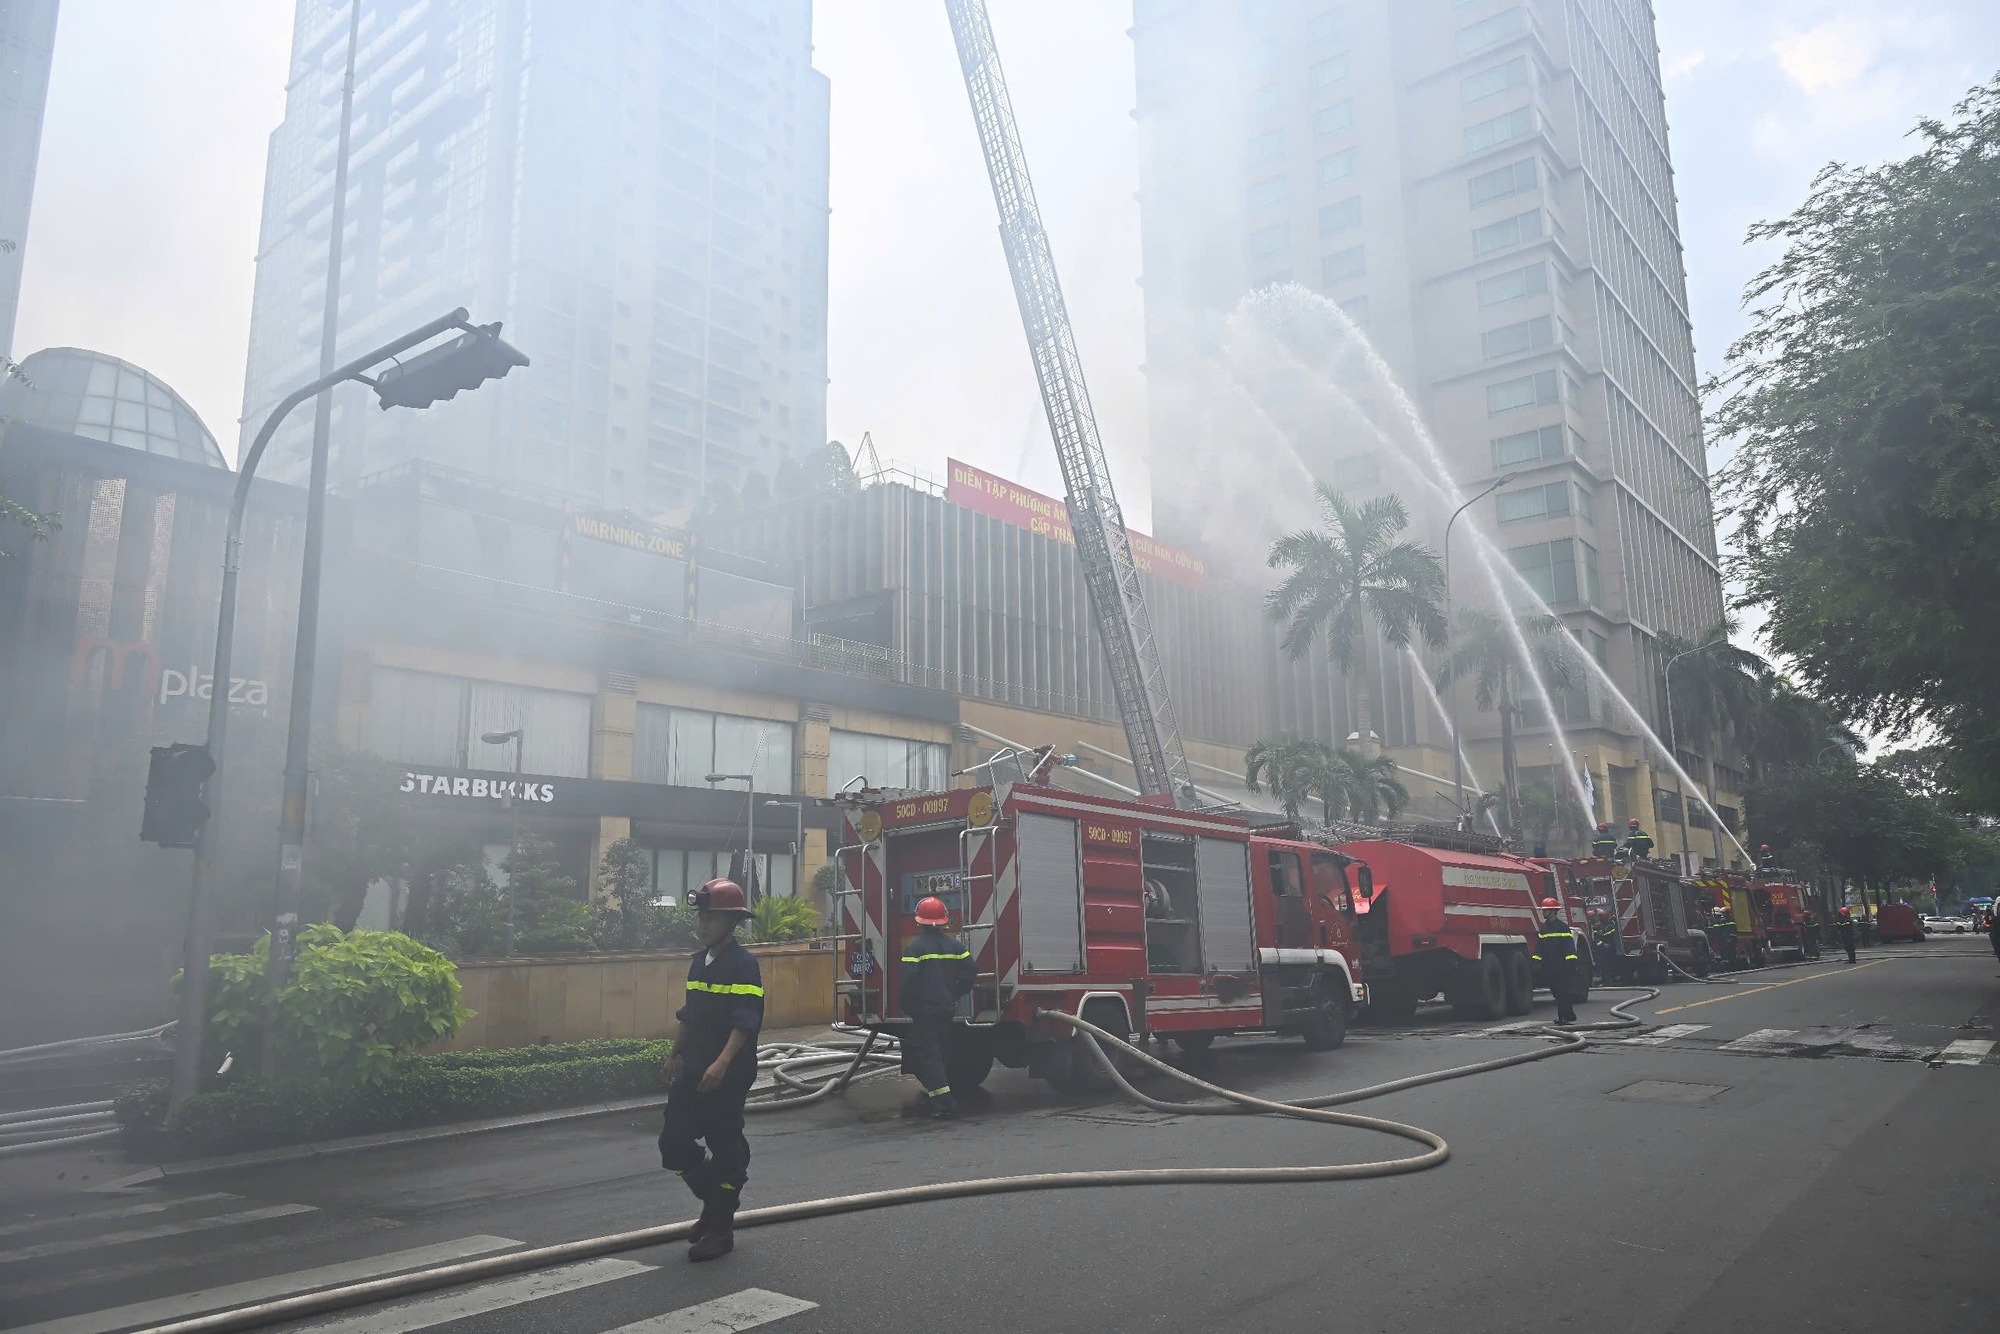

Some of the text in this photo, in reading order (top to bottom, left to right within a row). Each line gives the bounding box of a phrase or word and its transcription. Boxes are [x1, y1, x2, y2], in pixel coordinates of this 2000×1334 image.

[985, 478, 1007, 499] TẬP
[1009, 489, 1051, 517] PHƯƠNG
[576, 515, 685, 558] WARNING ZONE
[1030, 516, 1051, 535] CẤP
[160, 665, 268, 705] plaza
